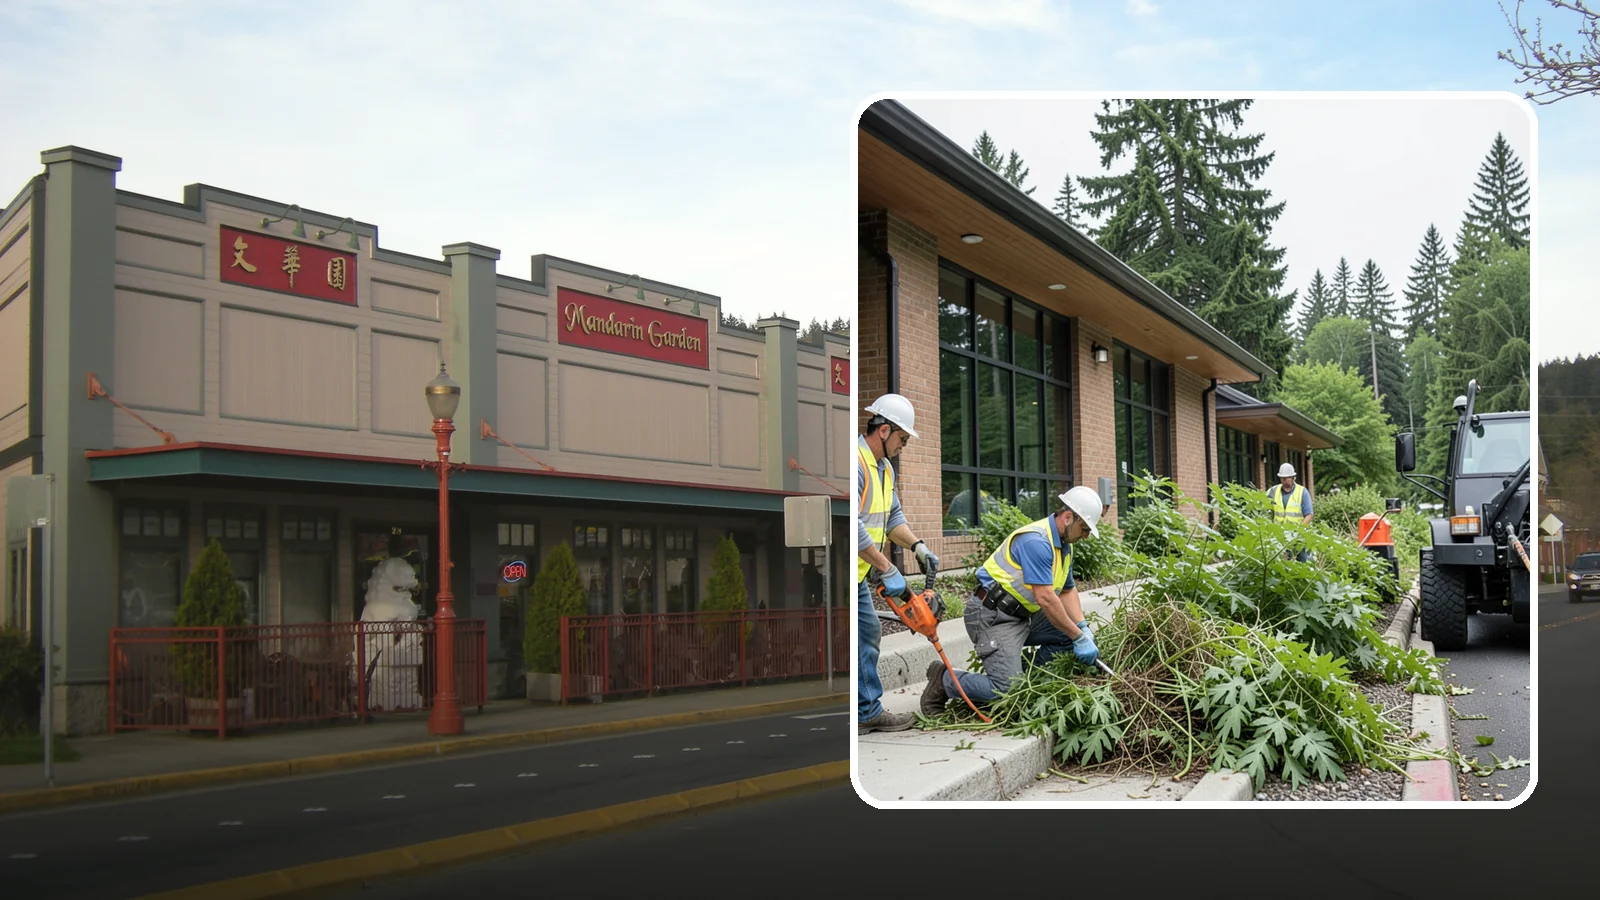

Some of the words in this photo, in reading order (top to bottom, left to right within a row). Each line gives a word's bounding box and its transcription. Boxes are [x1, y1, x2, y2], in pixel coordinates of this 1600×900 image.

[231, 235, 346, 291] 文華園
[564, 302, 643, 341] Mandarin
[648, 320, 702, 352] Garden
[835, 363, 846, 386] 文
[503, 564, 526, 578] OPEN
